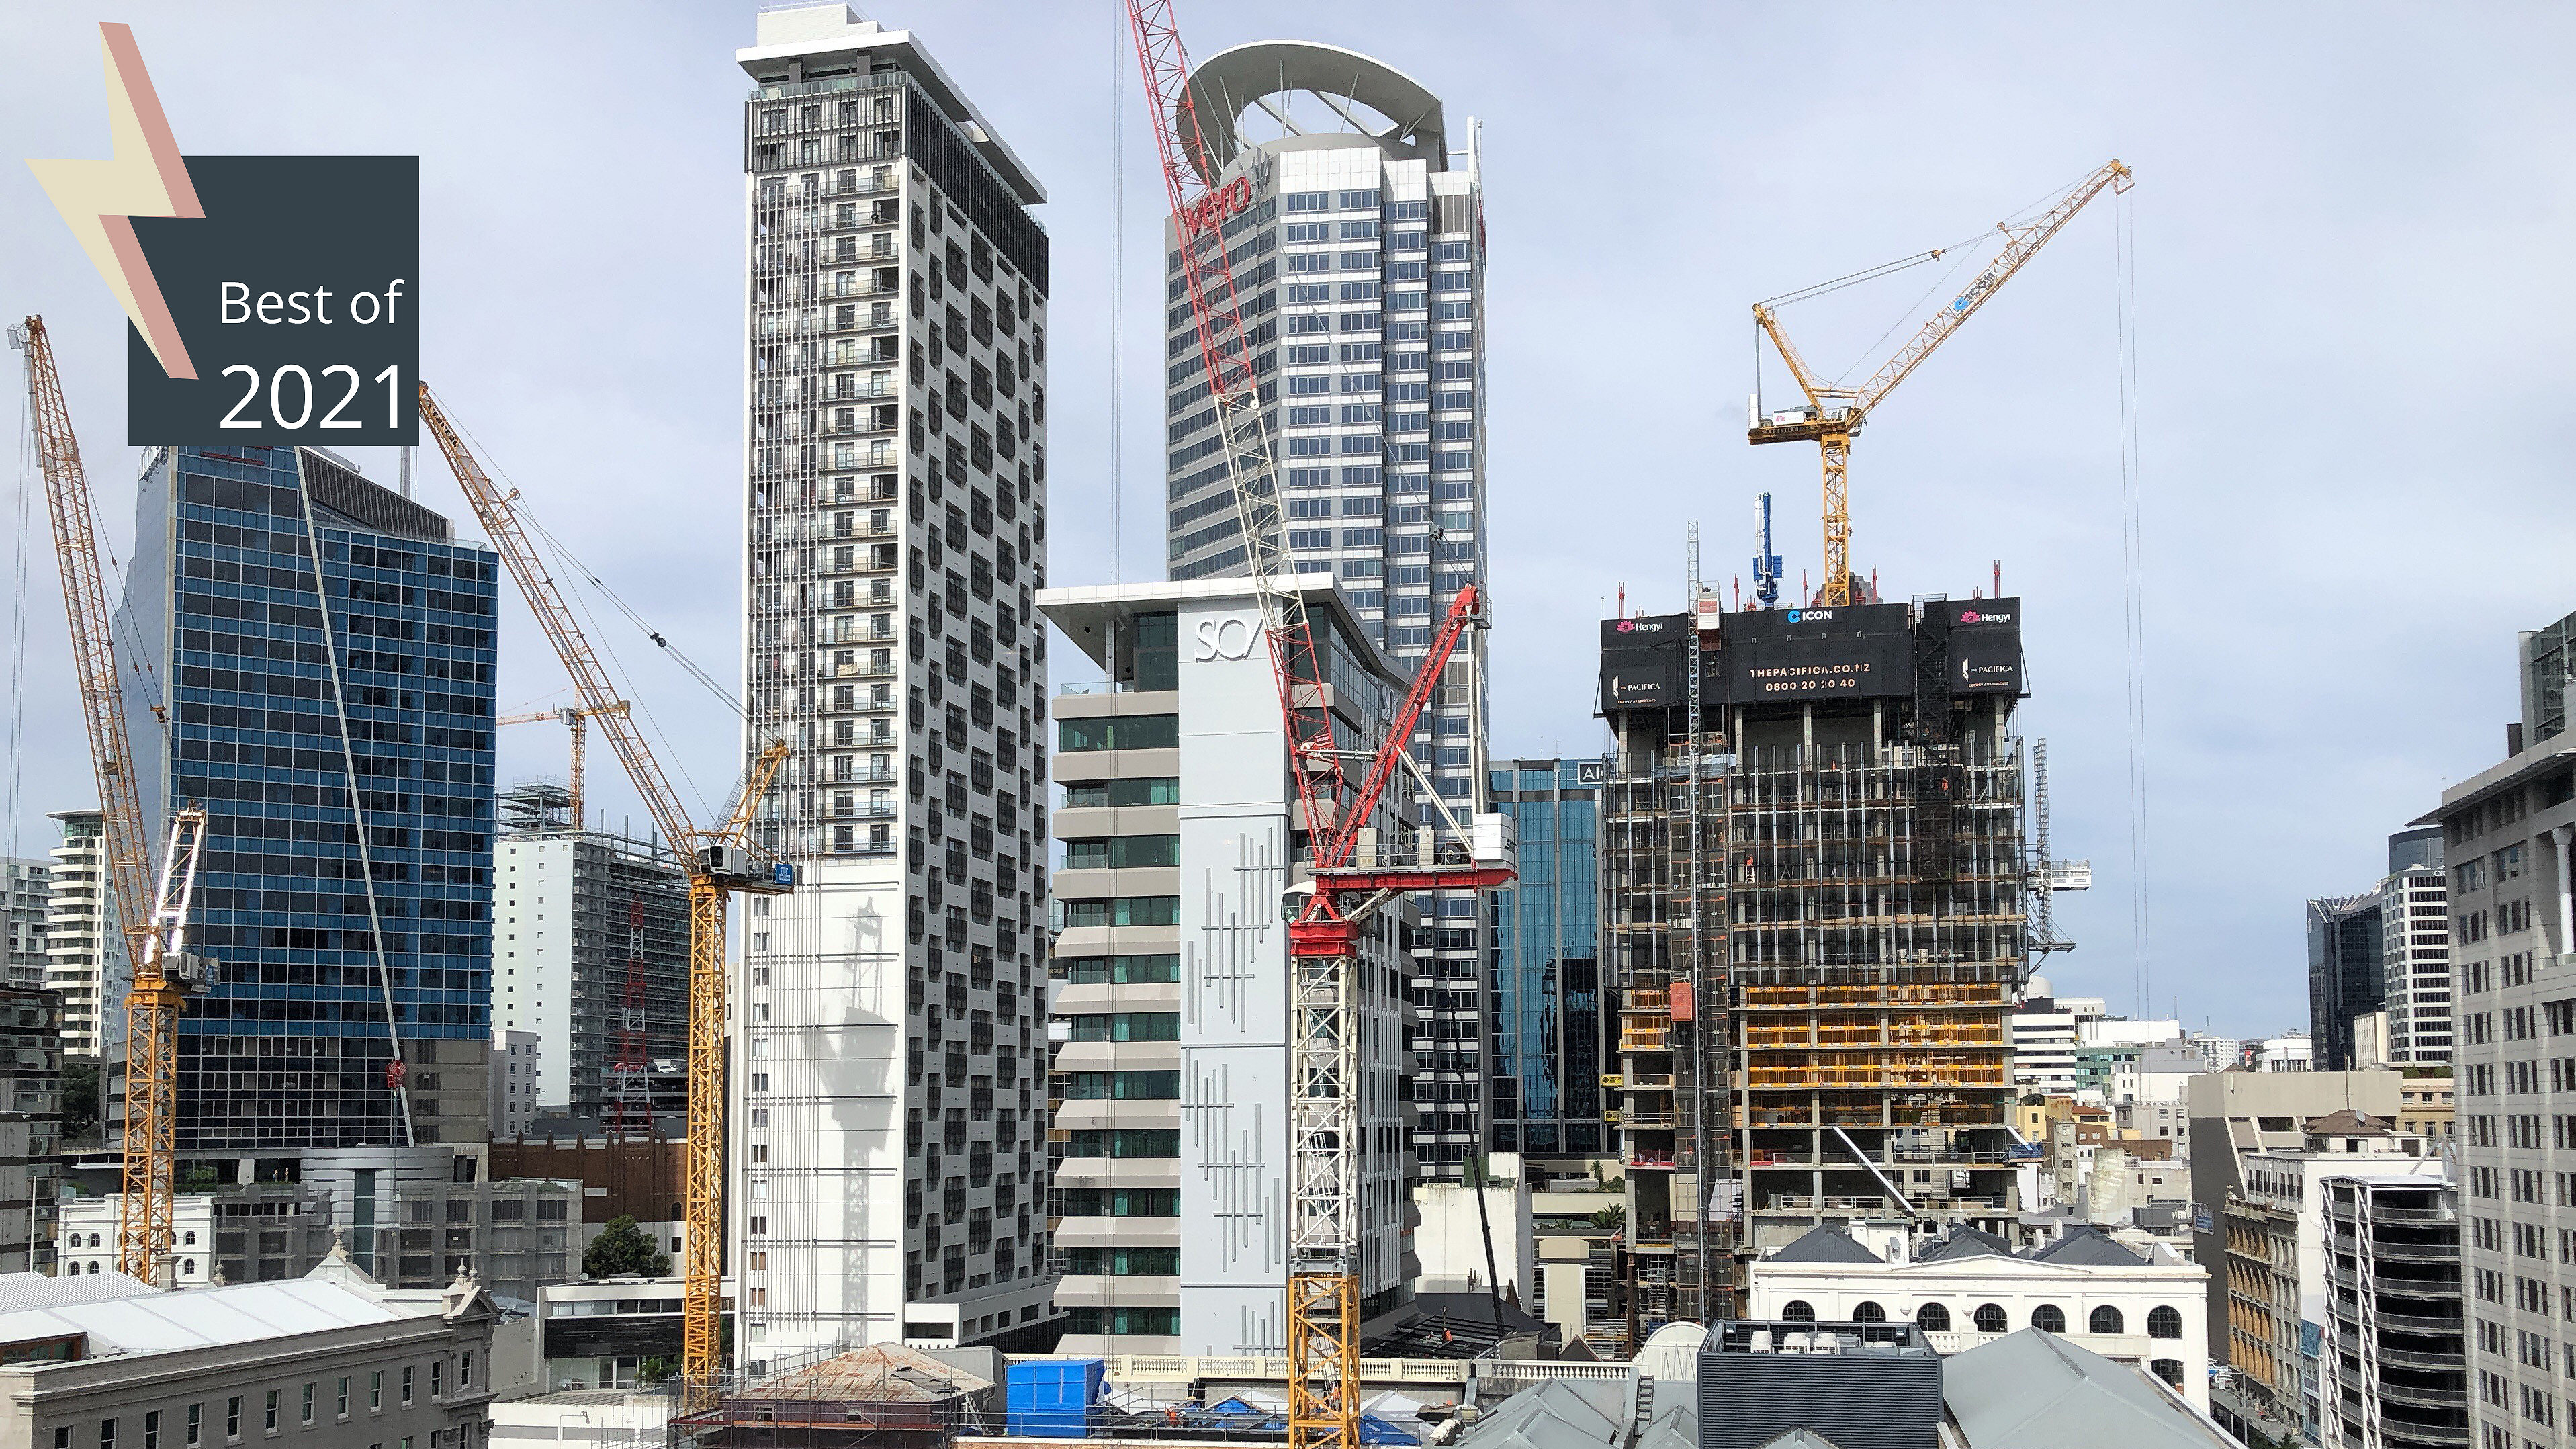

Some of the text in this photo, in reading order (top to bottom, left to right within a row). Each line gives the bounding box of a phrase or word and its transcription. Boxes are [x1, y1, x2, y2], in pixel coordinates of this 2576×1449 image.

[1802, 610, 1833, 621] ICON
[1982, 613, 2011, 623] Hengyi
[1636, 622, 1663, 633] Hengyi
[1749, 663, 1871, 678] THEPACIFICA.CO.NZ
[1978, 665, 2014, 674] PACIFICA
[1628, 683, 1660, 691] PACIFICA
[1765, 678, 1856, 692] 0800 20 20 40
[1583, 766, 1603, 781] AI
